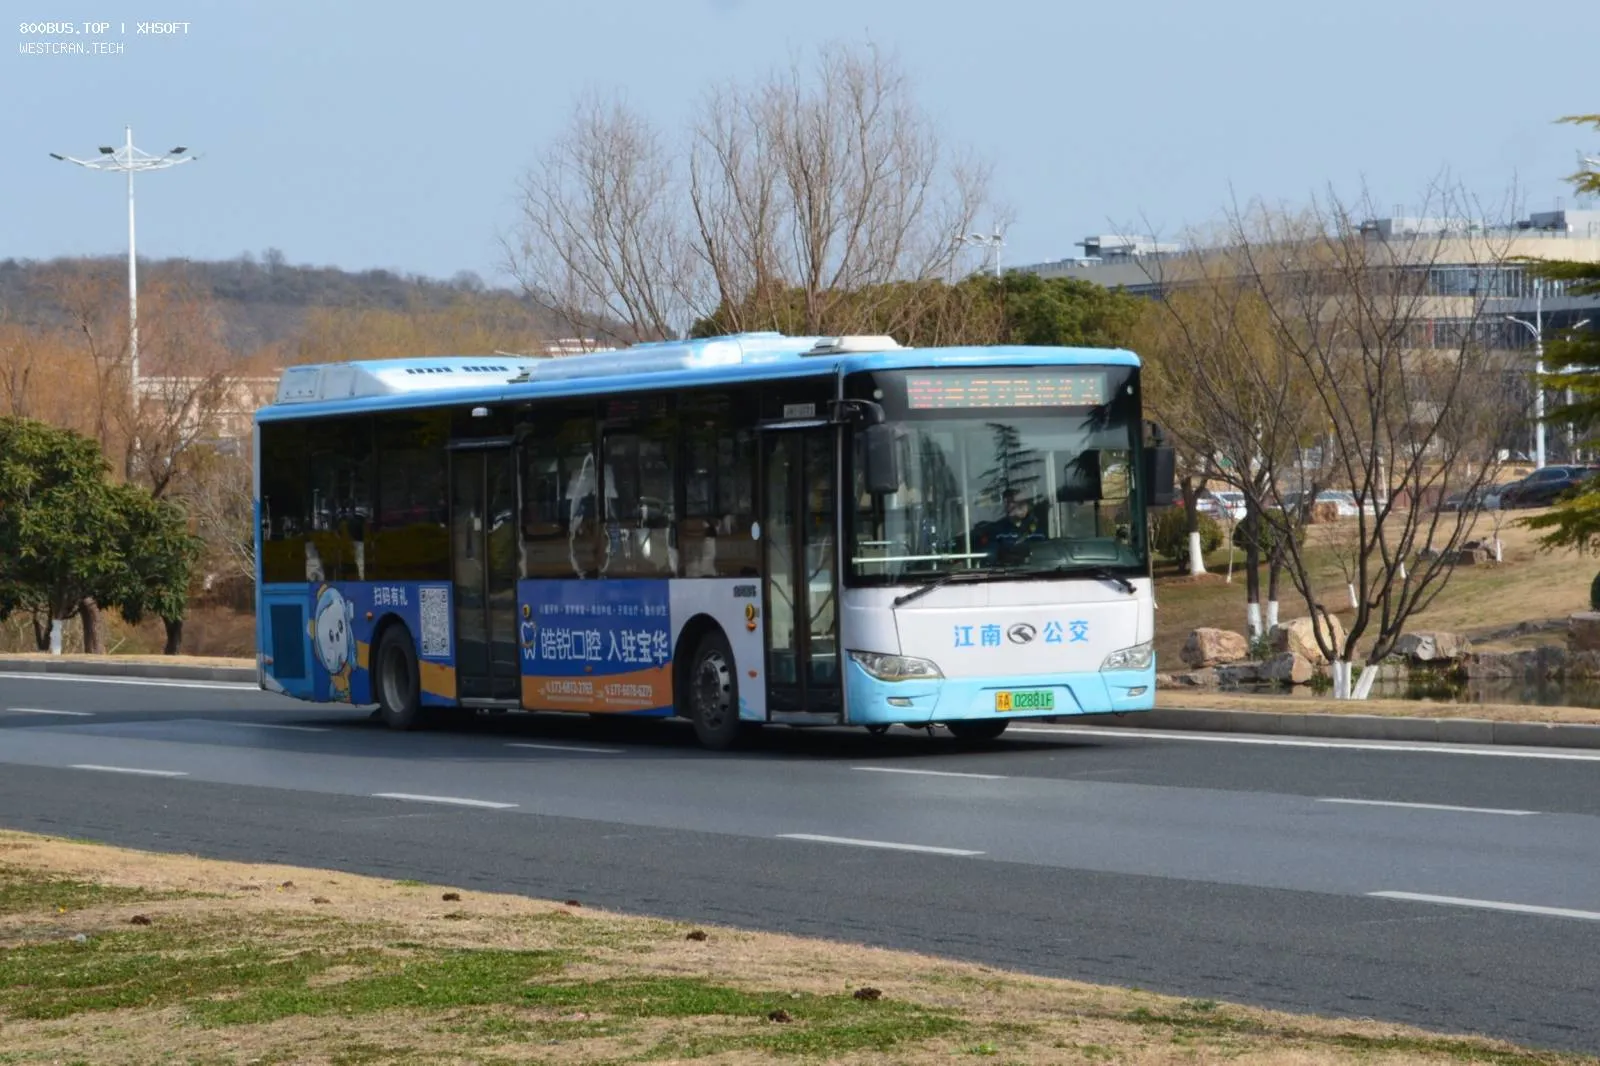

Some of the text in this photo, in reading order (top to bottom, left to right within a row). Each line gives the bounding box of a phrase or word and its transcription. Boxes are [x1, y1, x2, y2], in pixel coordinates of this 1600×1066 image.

[540, 628, 669, 664] 皓锐口腔 入驻宝华
[954, 620, 1089, 648] 江南 公交
